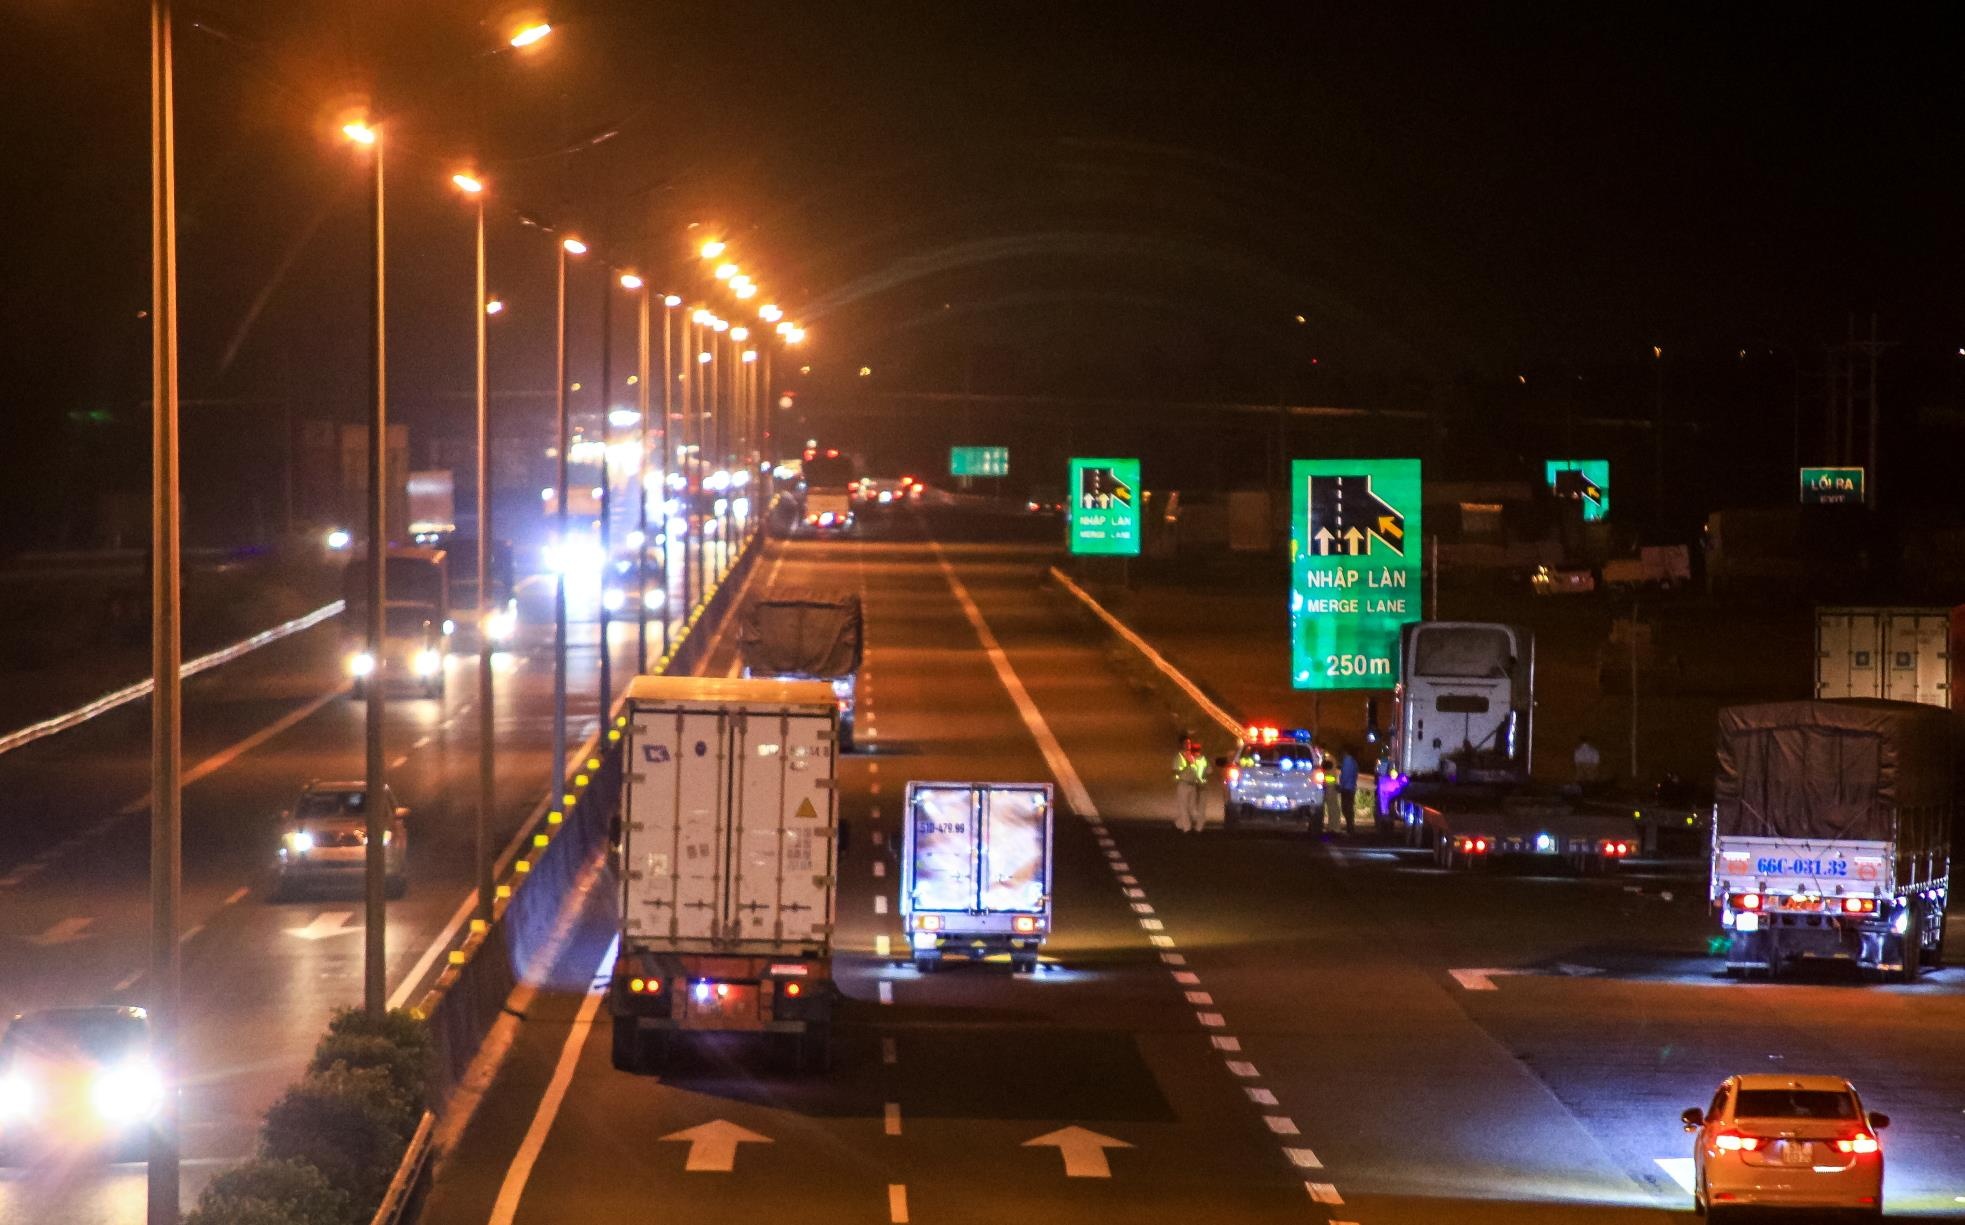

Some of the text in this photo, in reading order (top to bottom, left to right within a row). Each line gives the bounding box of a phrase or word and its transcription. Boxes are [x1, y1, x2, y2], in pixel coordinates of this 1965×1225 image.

[1836, 478, 1854, 490] RA
[1307, 566, 1406, 592] NHẬP LÀN
[1307, 599, 1406, 613] MERGE LANE
[1757, 857, 1847, 876] 66C-031.32
